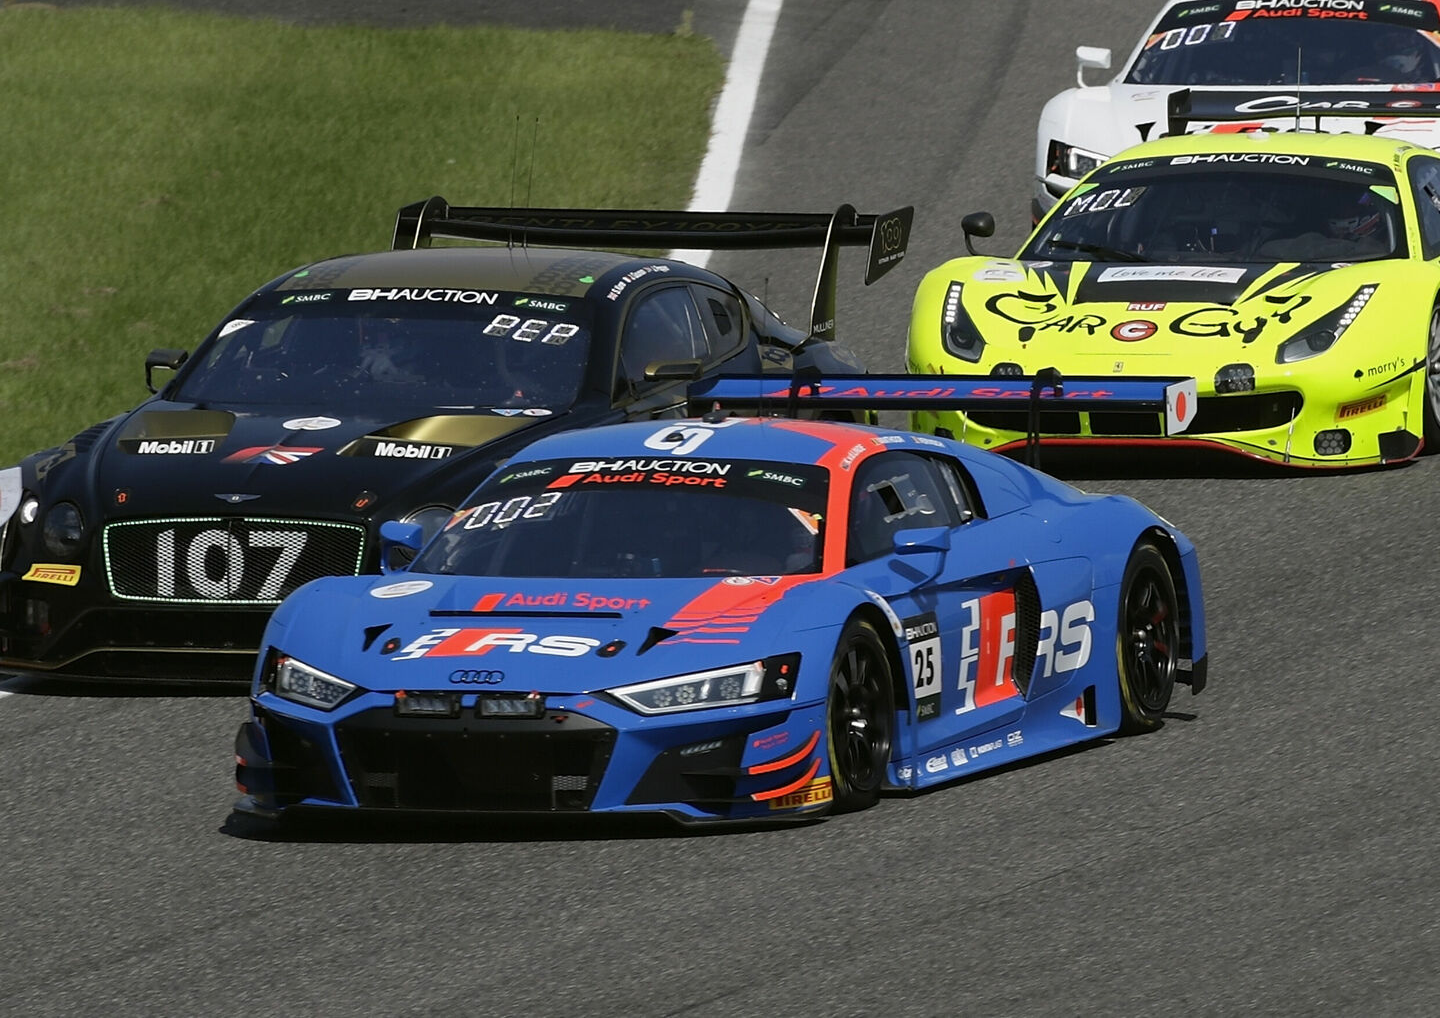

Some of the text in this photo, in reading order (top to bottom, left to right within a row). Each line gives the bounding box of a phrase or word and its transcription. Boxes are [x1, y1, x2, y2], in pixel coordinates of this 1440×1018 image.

[1189, 4, 1220, 16] SMBC
[1252, 8, 1369, 20] Audi Sport
[1391, 5, 1424, 18] SMBC
[1121, 161, 1154, 172] SMBC
[1169, 153, 1311, 167] BHAUCTION
[1339, 163, 1373, 175] SMBC
[1063, 187, 1134, 217] MOL
[295, 292, 331, 304] SMBC
[348, 288, 499, 305] BHAUCTION
[528, 299, 567, 312] SMBC
[1128, 302, 1165, 312] RUF
[482, 313, 580, 346] PEP
[1367, 356, 1406, 378] morry's
[830, 387, 956, 398] Audi
[1338, 393, 1387, 419] PIRELLI
[137, 439, 194, 455] Mobil
[374, 442, 430, 460] Mobil
[513, 467, 552, 480] SMBC
[568, 459, 731, 476] BHAUCTION
[583, 472, 728, 488] Audi Sport
[763, 472, 804, 487] SMBC
[463, 491, 563, 531] 002
[155, 528, 308, 600] 107
[27, 565, 76, 583] PIRELLI
[505, 592, 652, 610] Audi Sport
[467, 633, 601, 657] RS
[915, 646, 935, 689] 25
